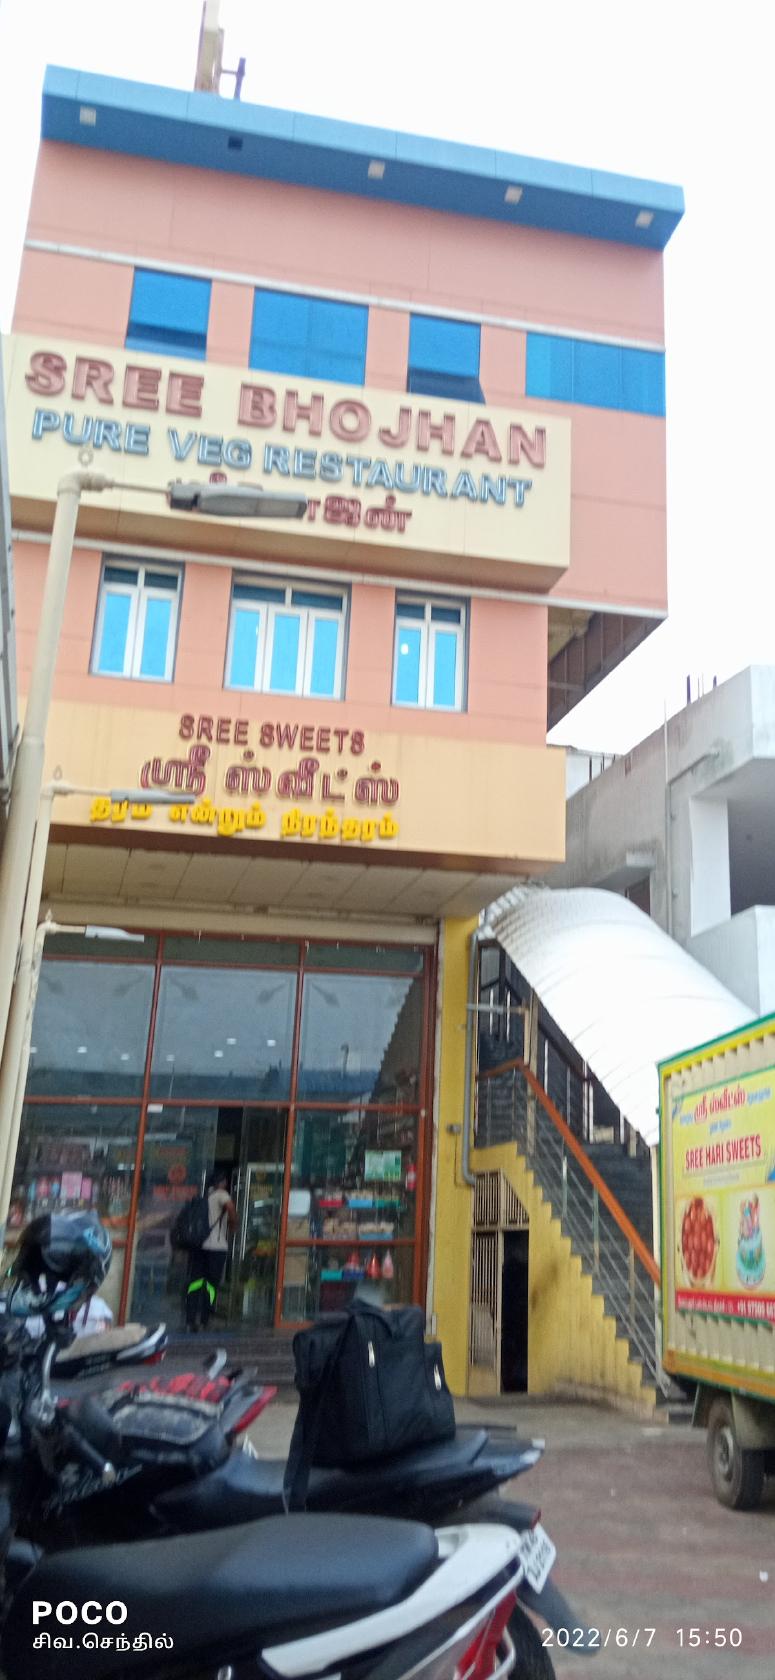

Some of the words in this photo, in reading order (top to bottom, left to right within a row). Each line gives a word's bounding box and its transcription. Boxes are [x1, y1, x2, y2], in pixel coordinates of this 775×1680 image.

[25, 350, 205, 418] SREE
[237, 381, 547, 469] BHOJHAN
[31, 407, 151, 457] PURE
[167, 427, 253, 470] VEG
[263, 442, 533, 508] RESTAURANT
[178, 714, 249, 745] SREE
[259, 722, 366, 756] SWEETS
[224, 749, 400, 807] ஸ்வீட்ஸ்
[685, 1146, 704, 1171] SREE
[705, 1142, 724, 1166] HARI
[726, 1134, 762, 1164] SWEETS
